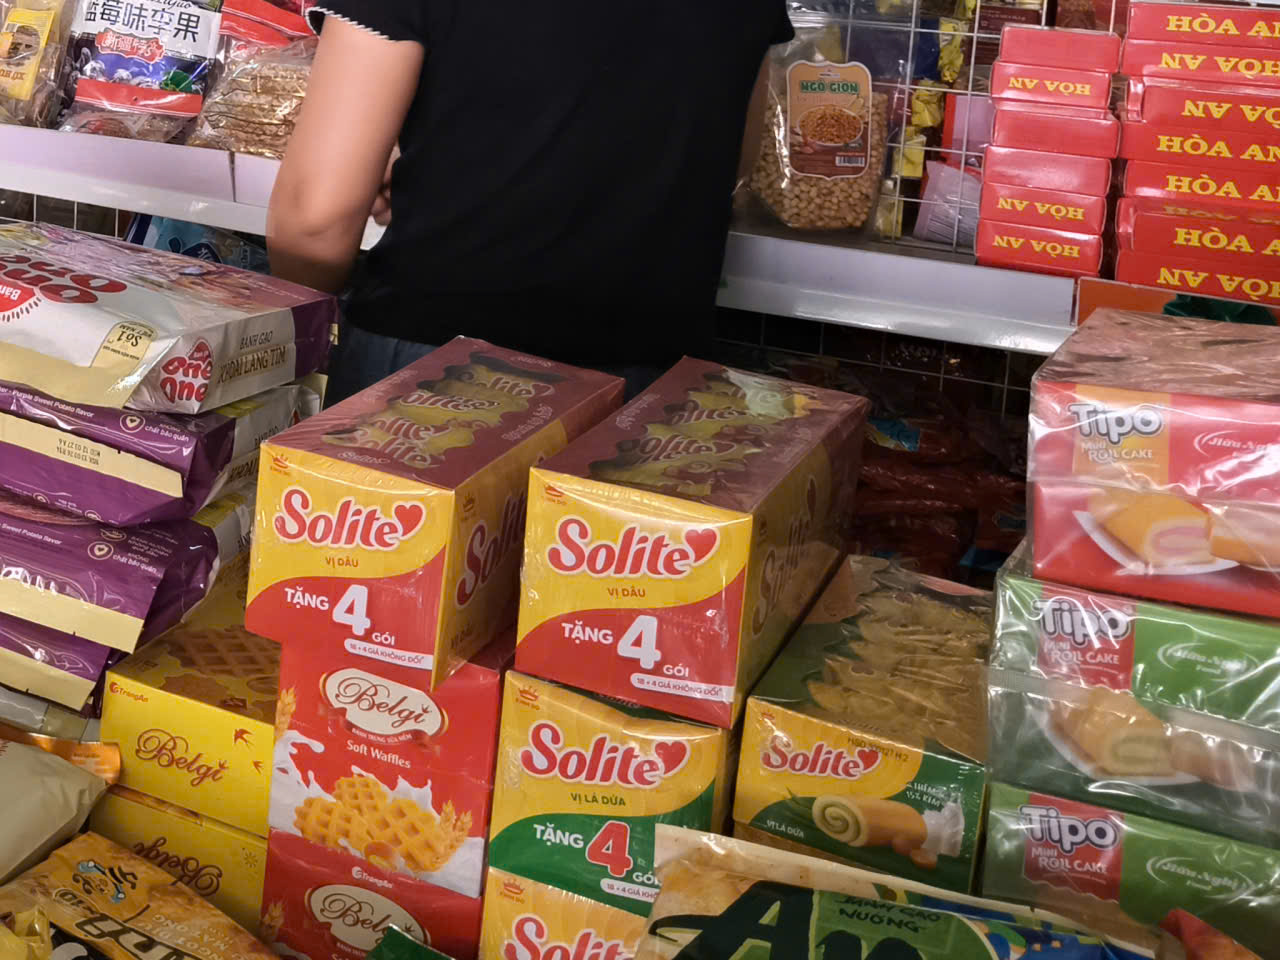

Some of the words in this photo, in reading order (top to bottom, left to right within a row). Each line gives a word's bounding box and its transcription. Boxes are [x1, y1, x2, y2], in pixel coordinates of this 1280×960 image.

[1167, 13, 1240, 35] HÒA
[1160, 53, 1208, 71] AN
[1009, 76, 1039, 89] AN
[1044, 79, 1091, 97] HÒA
[1182, 100, 1232, 119] AN
[1157, 134, 1233, 158] HÒA
[1165, 173, 1241, 198] HÒA
[1249, 185, 1280, 202] A
[997, 196, 1029, 211] AN
[1034, 202, 1085, 220] HÒA
[992, 234, 1024, 249] AN
[1030, 239, 1081, 258] HÒA
[1174, 227, 1254, 253] HÒA
[1157, 267, 1210, 288] AN
[161, 355, 213, 380] One
[160, 376, 210, 403] One
[12, 390, 33, 401] Purple
[33, 395, 54, 407] Sweet
[53, 400, 75, 412] Potato
[1121, 448, 1153, 460] CAKE
[274, 487, 401, 549] Solite
[1, 522, 22, 534] Sweet
[21, 528, 43, 540] Potato
[548, 515, 693, 578] Solite
[325, 556, 336, 569] VỊ
[337, 556, 359, 568] DÂU
[607, 587, 620, 600] VỊ
[621, 586, 646, 598] DÂU
[284, 586, 329, 611] TẶNG
[332, 584, 371, 636] 4
[372, 631, 396, 646] GÓI
[1031, 599, 1132, 647] Tipo
[380, 648, 407, 663] KHÔNG
[561, 620, 614, 645] TẶNG
[617, 615, 662, 670] 4
[662, 663, 690, 678] GÓI
[1086, 652, 1120, 666] CAKE
[672, 681, 703, 695] KHÔNG
[346, 739, 370, 756] Soft
[370, 745, 412, 770] Waffles
[520, 720, 662, 788] Solite
[761, 733, 863, 780] Solite
[570, 792, 583, 805] VỊ
[584, 792, 599, 805] LÁ
[1020, 805, 1120, 854] Tipo
[533, 822, 585, 849] TẶNG
[586, 819, 634, 877] 4
[1031, 846, 1058, 858] MINI
[1039, 856, 1072, 871] ROLL
[1073, 859, 1108, 874] CAKE
